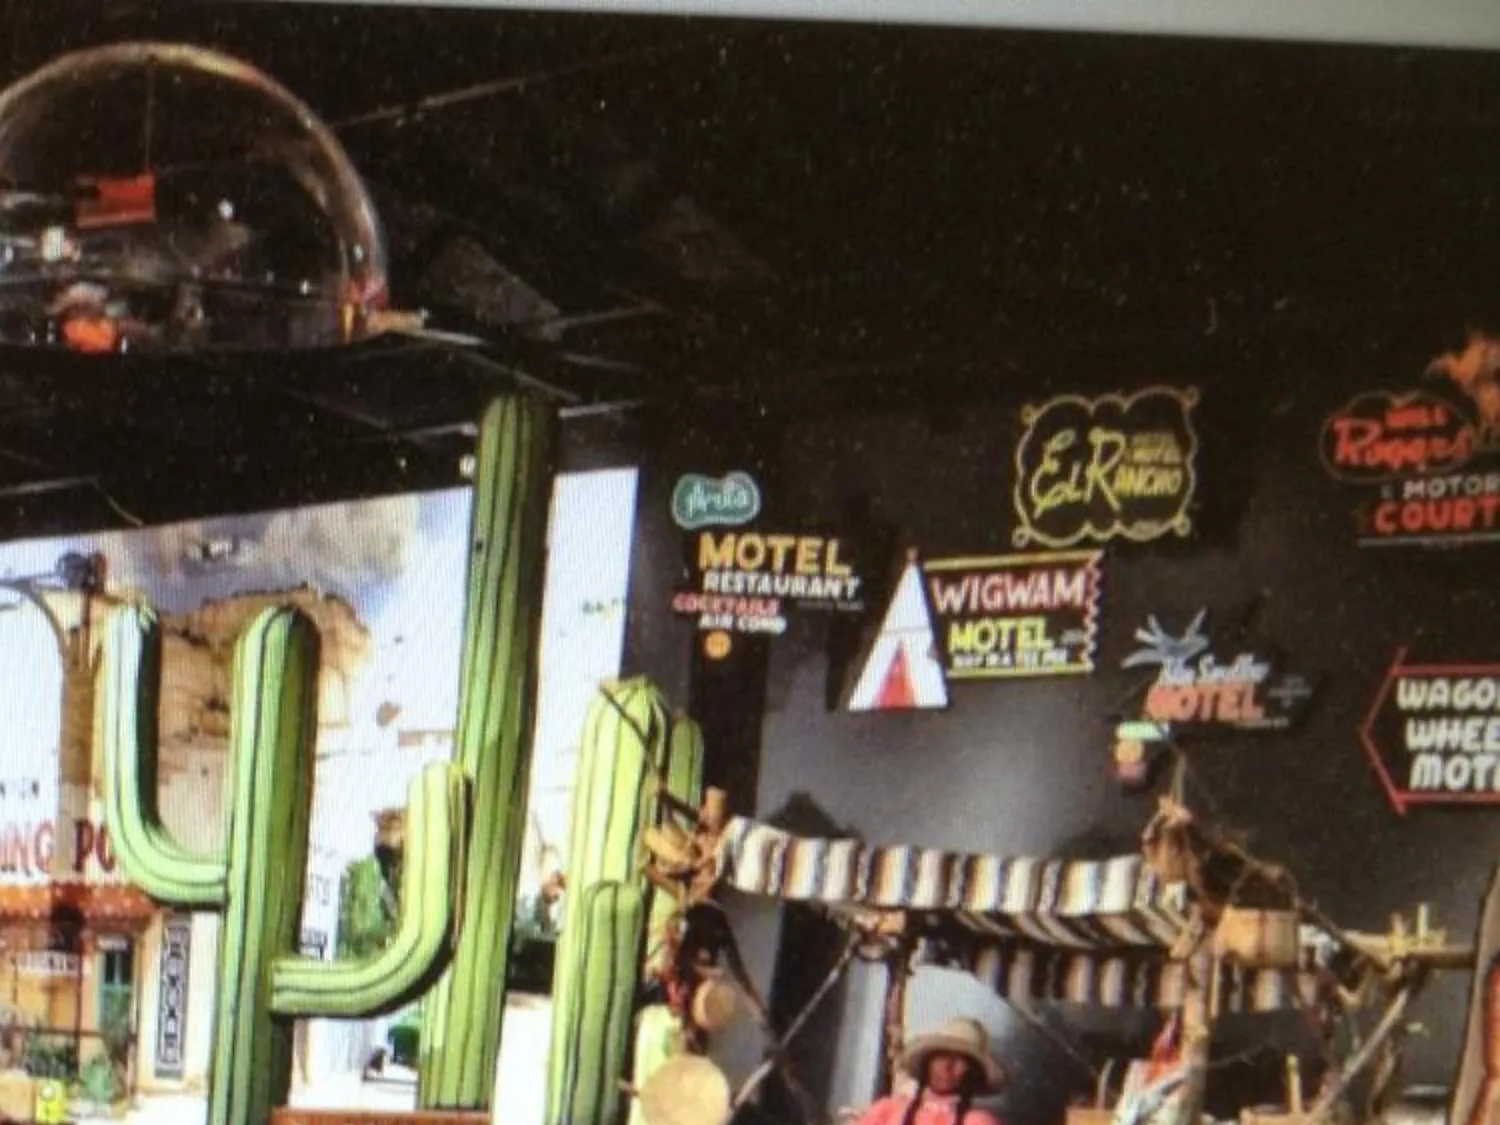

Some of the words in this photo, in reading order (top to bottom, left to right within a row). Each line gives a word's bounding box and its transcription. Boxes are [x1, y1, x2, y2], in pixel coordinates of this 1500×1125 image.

[1403, 472, 1500, 499] MOTOR
[1374, 496, 1500, 534] COURT
[698, 531, 852, 577] MOTEL
[703, 568, 862, 599] RESTAURANT
[932, 569, 1087, 614] WIGWAM
[948, 616, 1055, 654] MOTEL
[1147, 682, 1265, 722] MOTEL
[1405, 716, 1500, 753] WHEE
